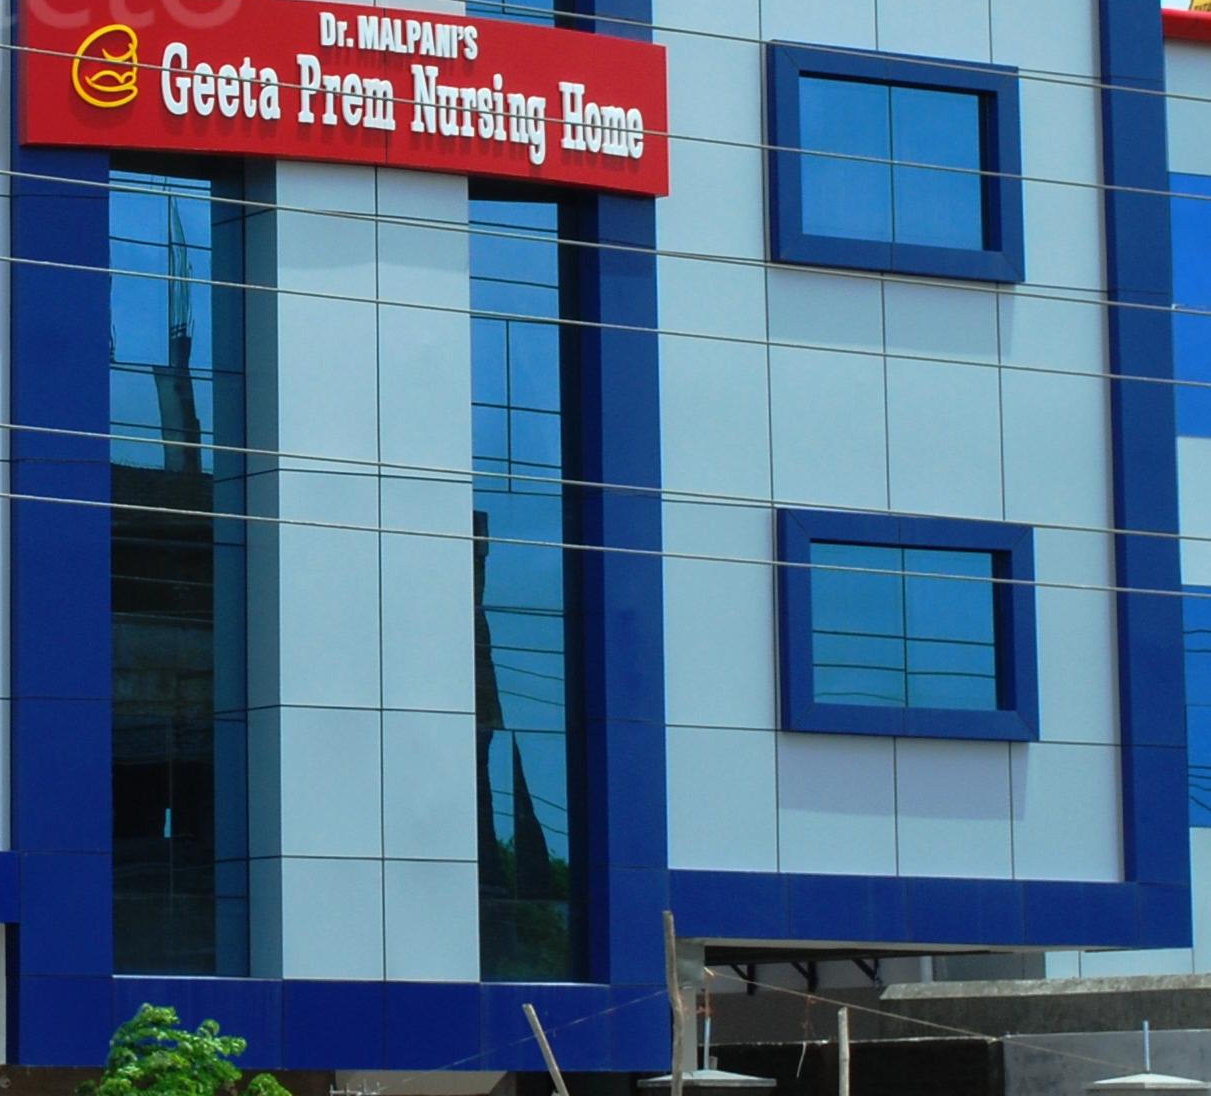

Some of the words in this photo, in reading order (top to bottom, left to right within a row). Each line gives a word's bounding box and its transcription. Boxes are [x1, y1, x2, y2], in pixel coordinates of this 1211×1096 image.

[321, 11, 354, 48] Dr.
[357, 15, 478, 61] MALPANI'S
[161, 42, 281, 120] Geeta
[296, 53, 396, 133] Prem
[411, 64, 547, 165] Nursing
[559, 81, 644, 160] Home
